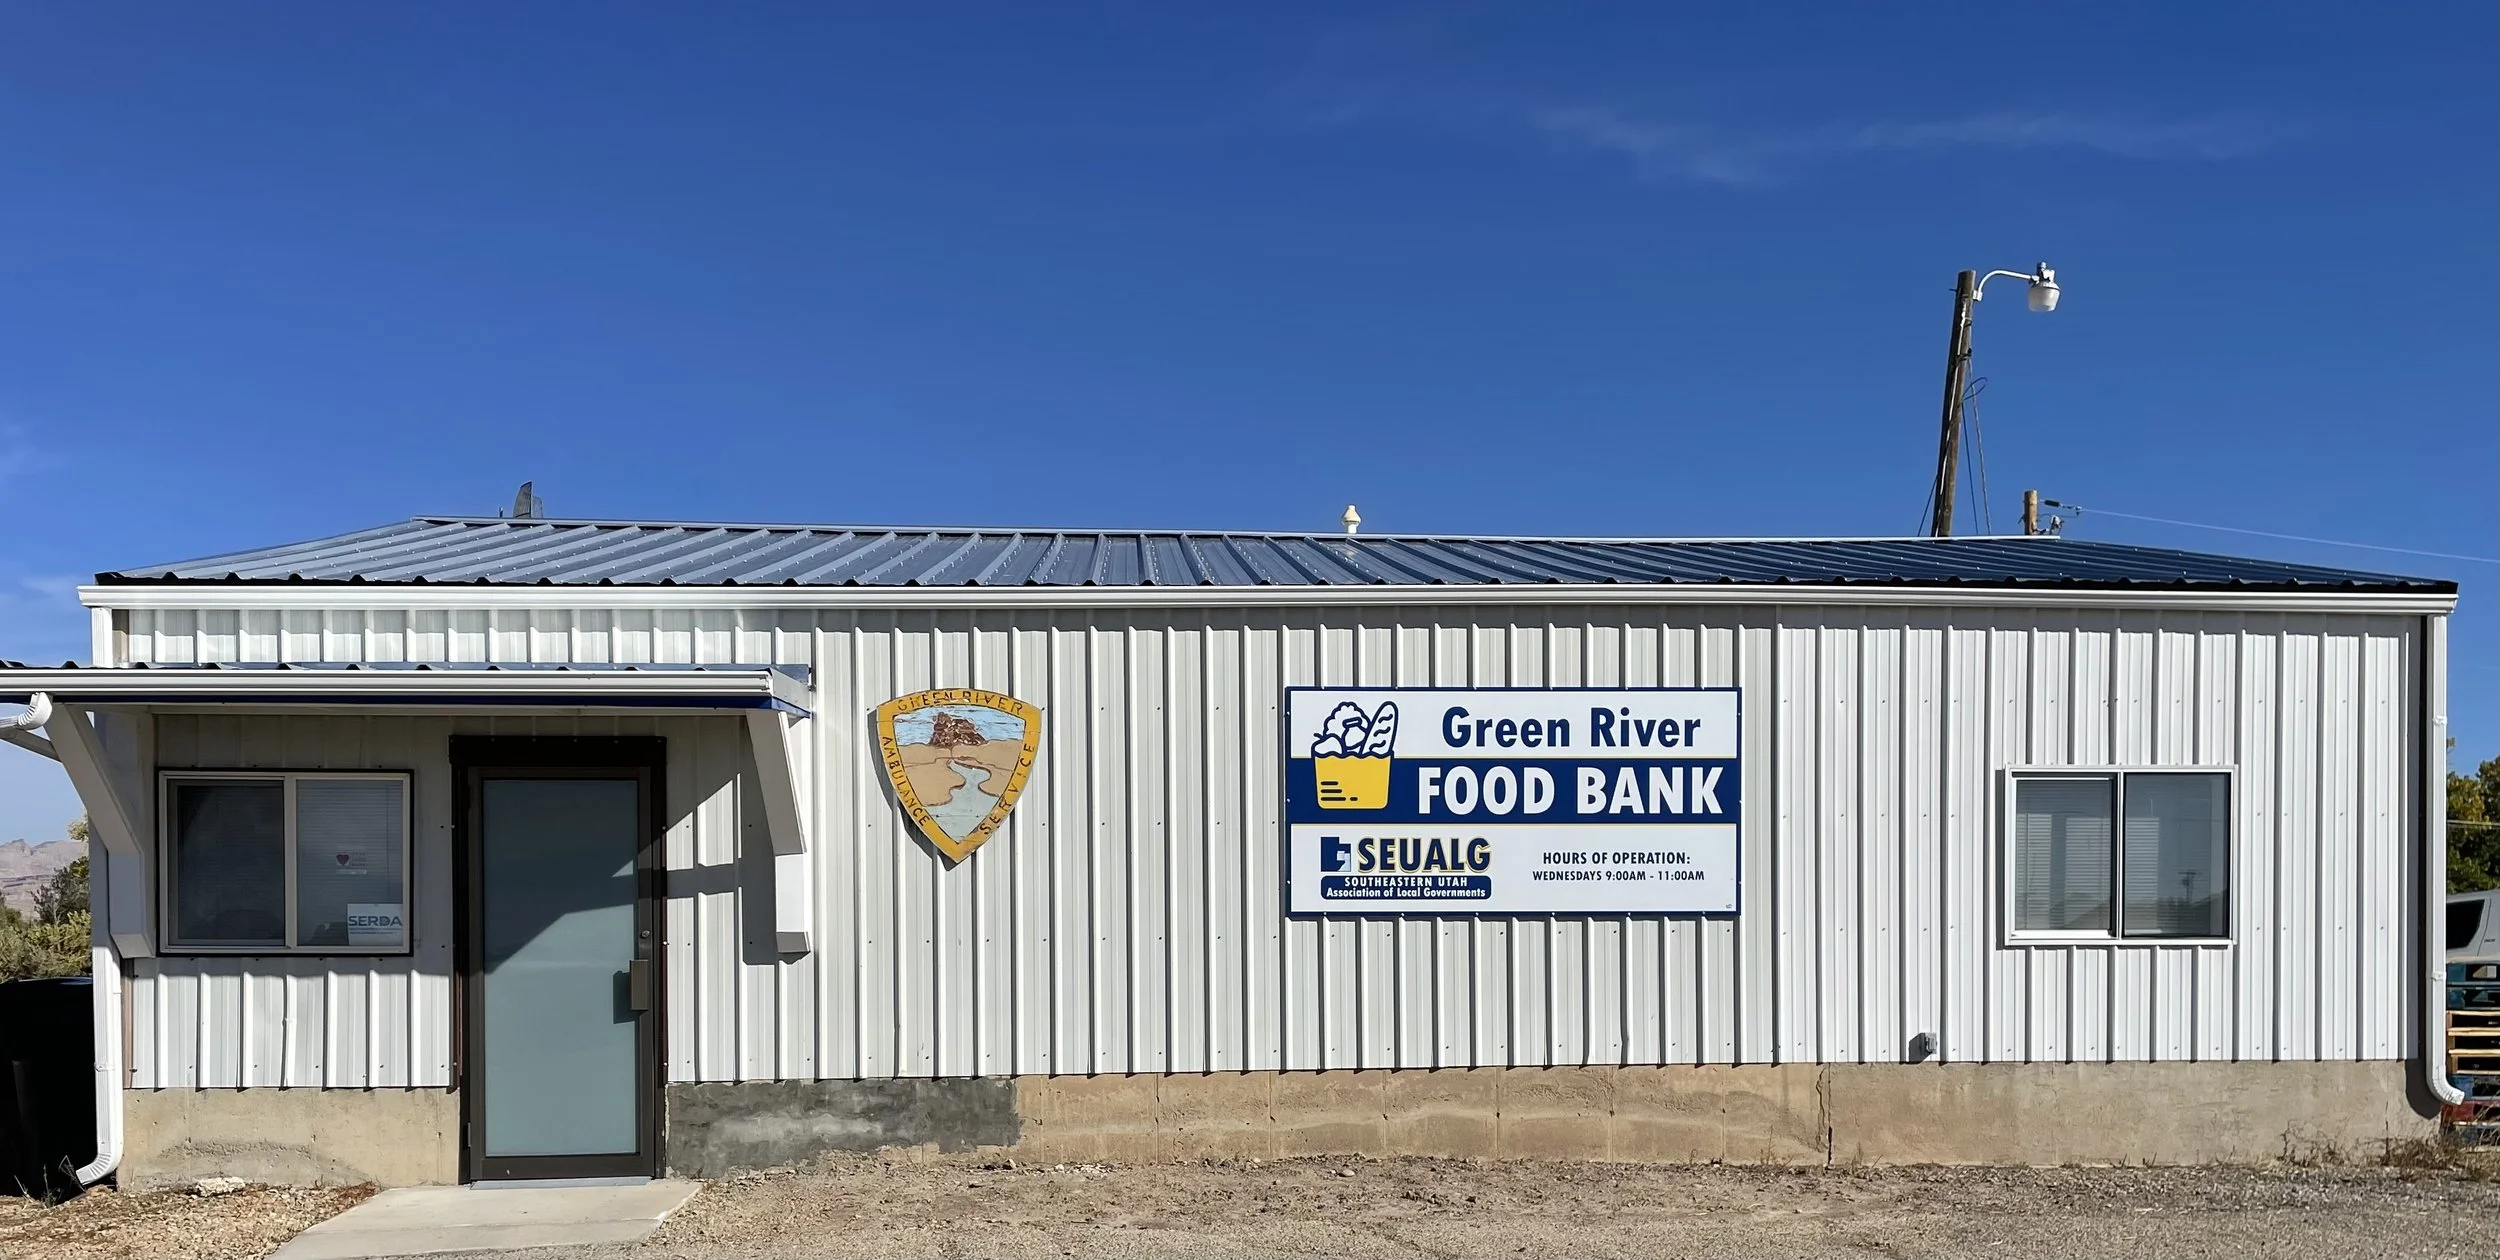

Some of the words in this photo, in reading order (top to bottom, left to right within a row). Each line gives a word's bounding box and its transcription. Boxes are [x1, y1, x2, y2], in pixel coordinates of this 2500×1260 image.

[962, 691, 1023, 715] RIVER
[1442, 706, 1570, 748] Green
[1590, 707, 1701, 747] River
[882, 736, 930, 827] AMBULANCE
[979, 743, 1035, 835] SERVICE
[1418, 765, 1555, 815] FOOD
[1576, 766, 1724, 815] BANK
[1357, 837, 1491, 873] SEUALG
[1543, 852, 1587, 865] HOURS
[1591, 852, 1608, 865] OF
[1612, 852, 1691, 865] OPERATION:
[1344, 876, 1433, 887] SOUTHEASTERN
[1438, 877, 1468, 887] UTAH
[1532, 871, 1602, 881] WEDNESDAYS
[1605, 871, 1646, 881] 9:00AM
[1657, 871, 1705, 881] 11:00AM
[1326, 887, 1381, 898] Association
[1383, 887, 1395, 898] of
[1397, 887, 1421, 898] Local
[1423, 887, 1486, 898] Governments
[348, 915, 403, 927] SERDA
